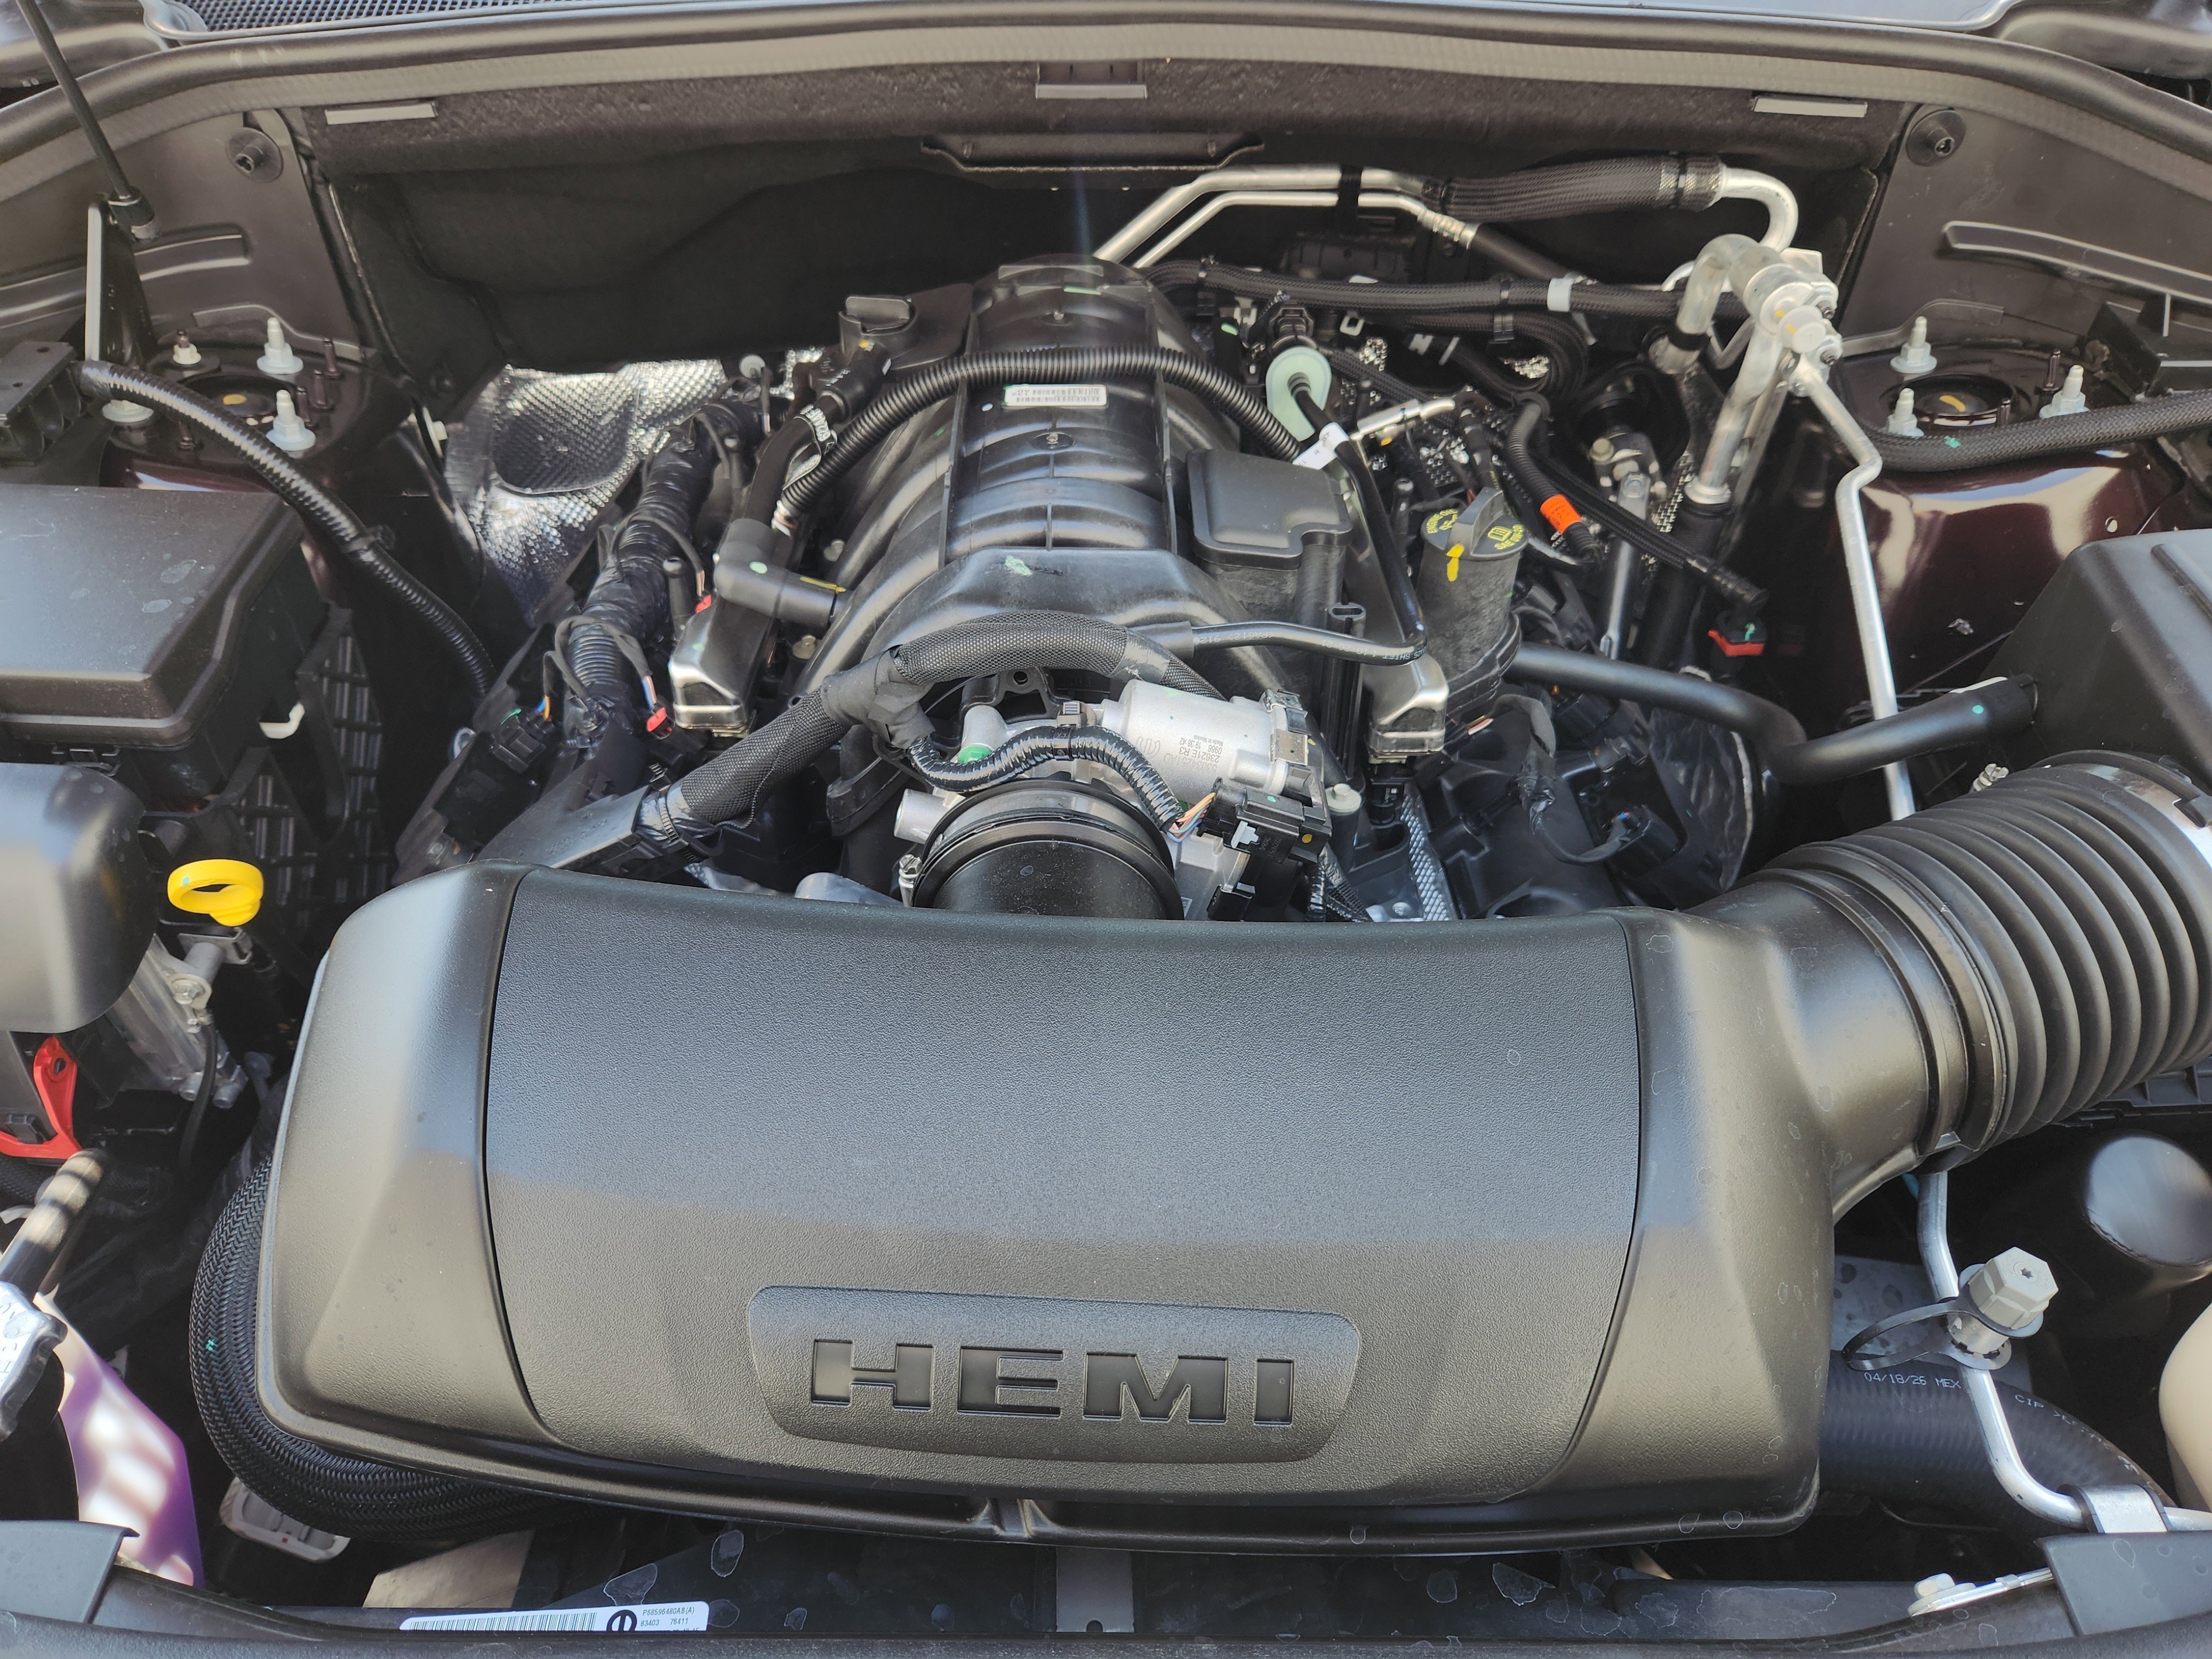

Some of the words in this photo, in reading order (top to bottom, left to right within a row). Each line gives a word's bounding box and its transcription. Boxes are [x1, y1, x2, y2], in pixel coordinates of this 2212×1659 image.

[1426, 513, 1444, 534] ENGINE
[1494, 539, 1515, 550] SAE
[1193, 635, 1221, 645] 9126
[1382, 652, 1411, 660] SHIFT
[1179, 747, 1191, 756] R3
[1208, 744, 1222, 755] 0986
[1192, 749, 1220, 763] 23621E
[810, 1337, 1296, 1427] HEMI
[1864, 1371, 1927, 1387] 04/18/26
[1935, 1376, 1962, 1390] MEX
